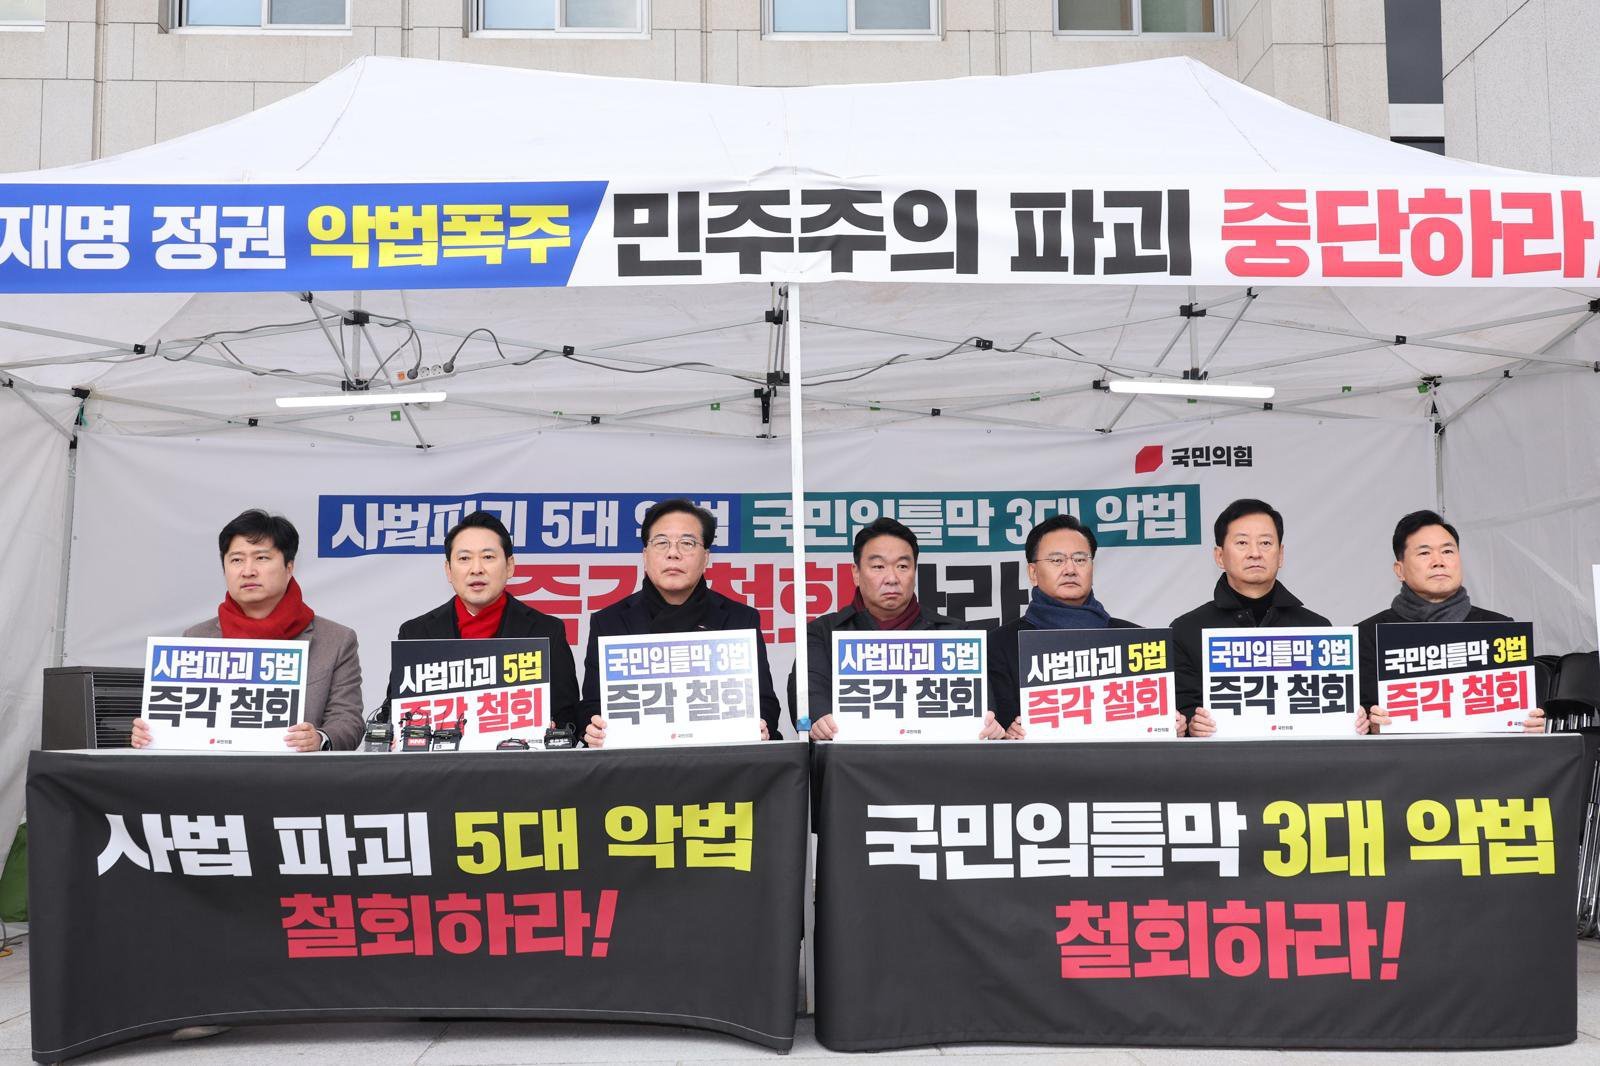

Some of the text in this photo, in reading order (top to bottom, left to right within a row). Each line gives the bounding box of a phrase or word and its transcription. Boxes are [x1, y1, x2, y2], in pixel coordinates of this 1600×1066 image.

[0, 188, 1600, 278] 재명 정권 악법폭주 민주주의 파괴 중단하라
[1171, 446, 1252, 467] 국민의힘
[541, 500, 619, 547] 5대
[1096, 492, 1187, 540] 악법
[154, 650, 300, 681] 사법파괴 5법
[400, 650, 541, 694] 사법파괴 5법
[608, 642, 750, 676] 국민입틀막 3법
[841, 643, 979, 671] 사법파괴 5법
[1027, 640, 1167, 683] 사법파괴 5법
[1211, 639, 1350, 668] 국민입틀막 3법
[1384, 636, 1527, 674] 국민입틀막 3법
[148, 686, 300, 729] 즉각 철회
[476, 687, 542, 733] 철회
[607, 678, 755, 725] 즉각 철회
[838, 677, 982, 719] 즉각 철회
[1028, 676, 1168, 728] 즉각 철회
[1210, 673, 1354, 715] 즉각 철회
[1387, 671, 1528, 721] 즉각 철회
[97, 801, 754, 877] 사법 파괴 5대 악법
[865, 797, 1556, 881] 국민입틀막 3대 악법
[280, 890, 619, 959] 철회하라!
[1055, 899, 1406, 981] 철회하라!
